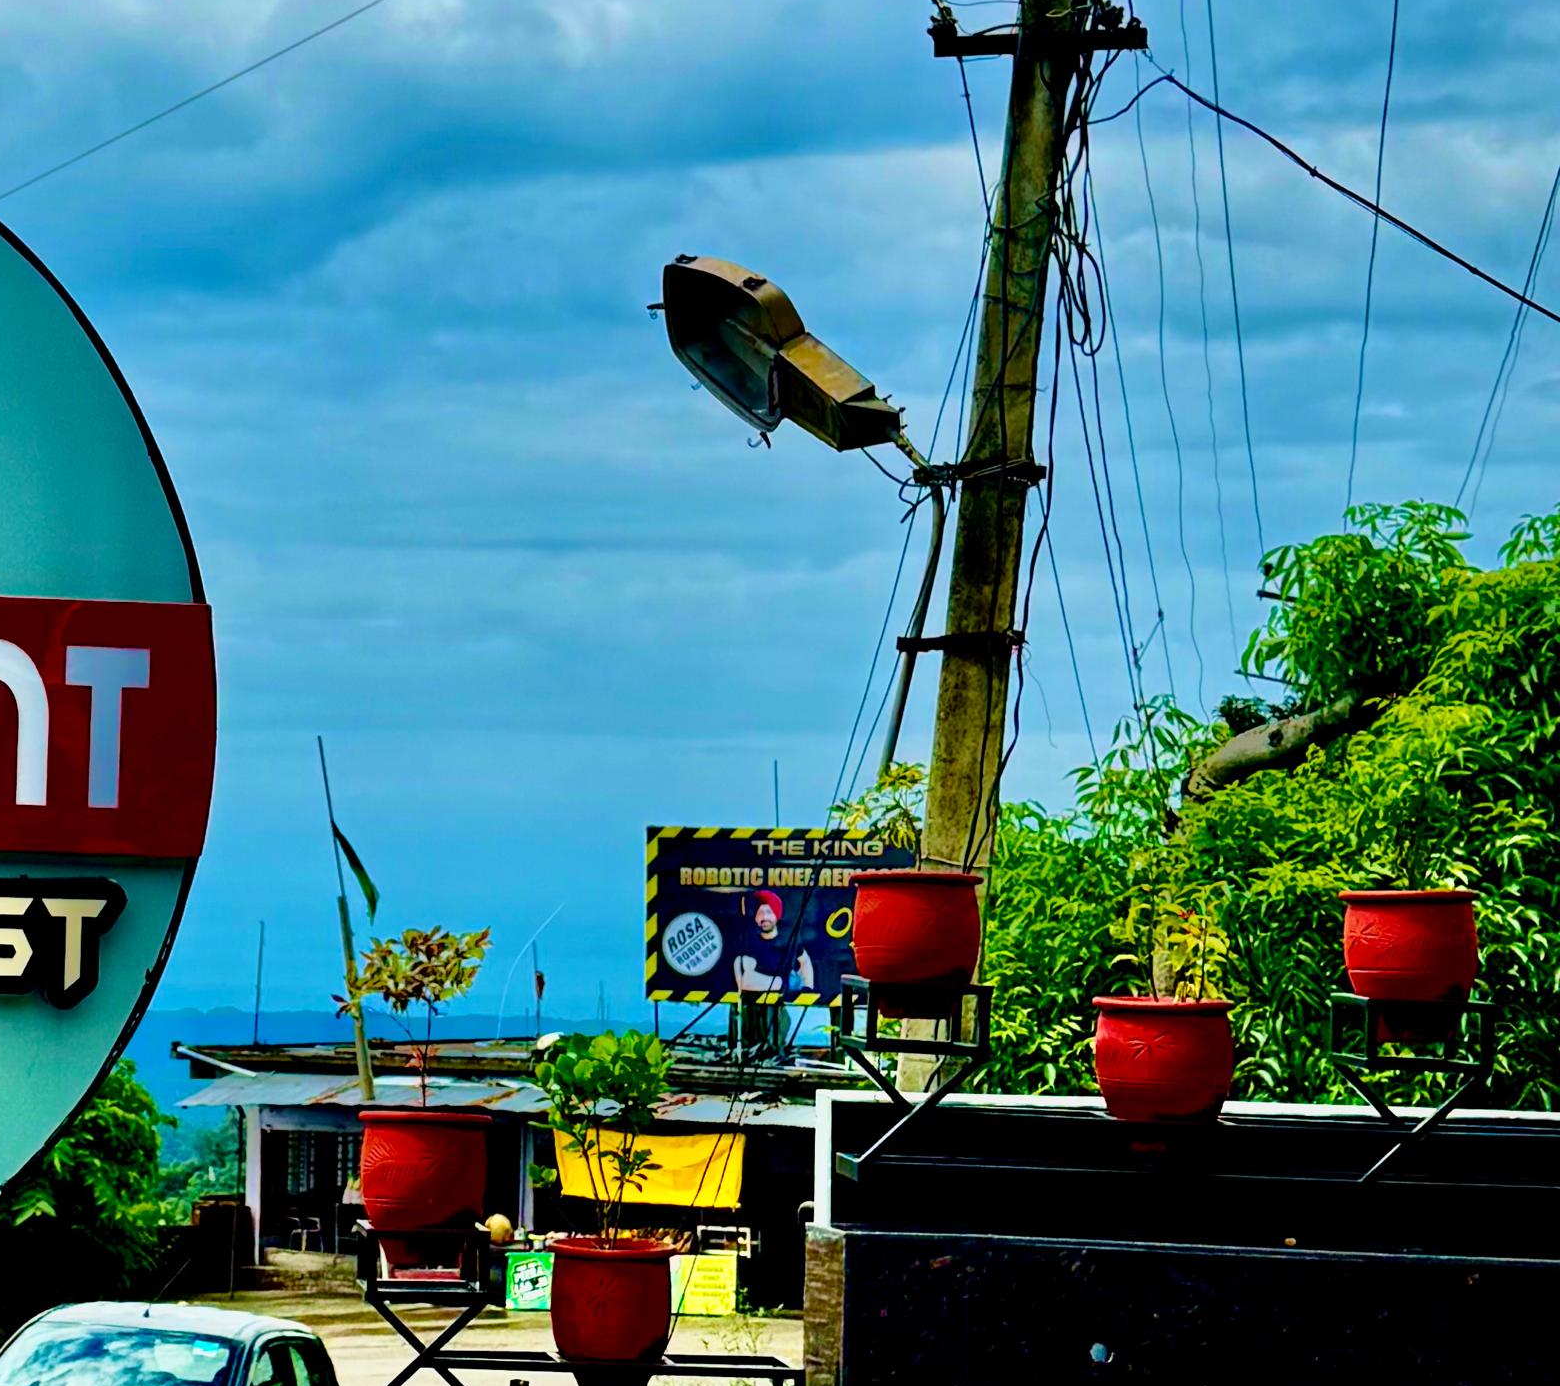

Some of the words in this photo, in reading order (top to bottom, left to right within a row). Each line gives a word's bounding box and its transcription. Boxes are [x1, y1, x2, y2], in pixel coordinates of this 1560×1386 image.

[751, 840, 806, 856] THE
[813, 840, 885, 857] KING
[679, 867, 764, 887] ROBOTIC
[667, 916, 704, 954] ROSA
